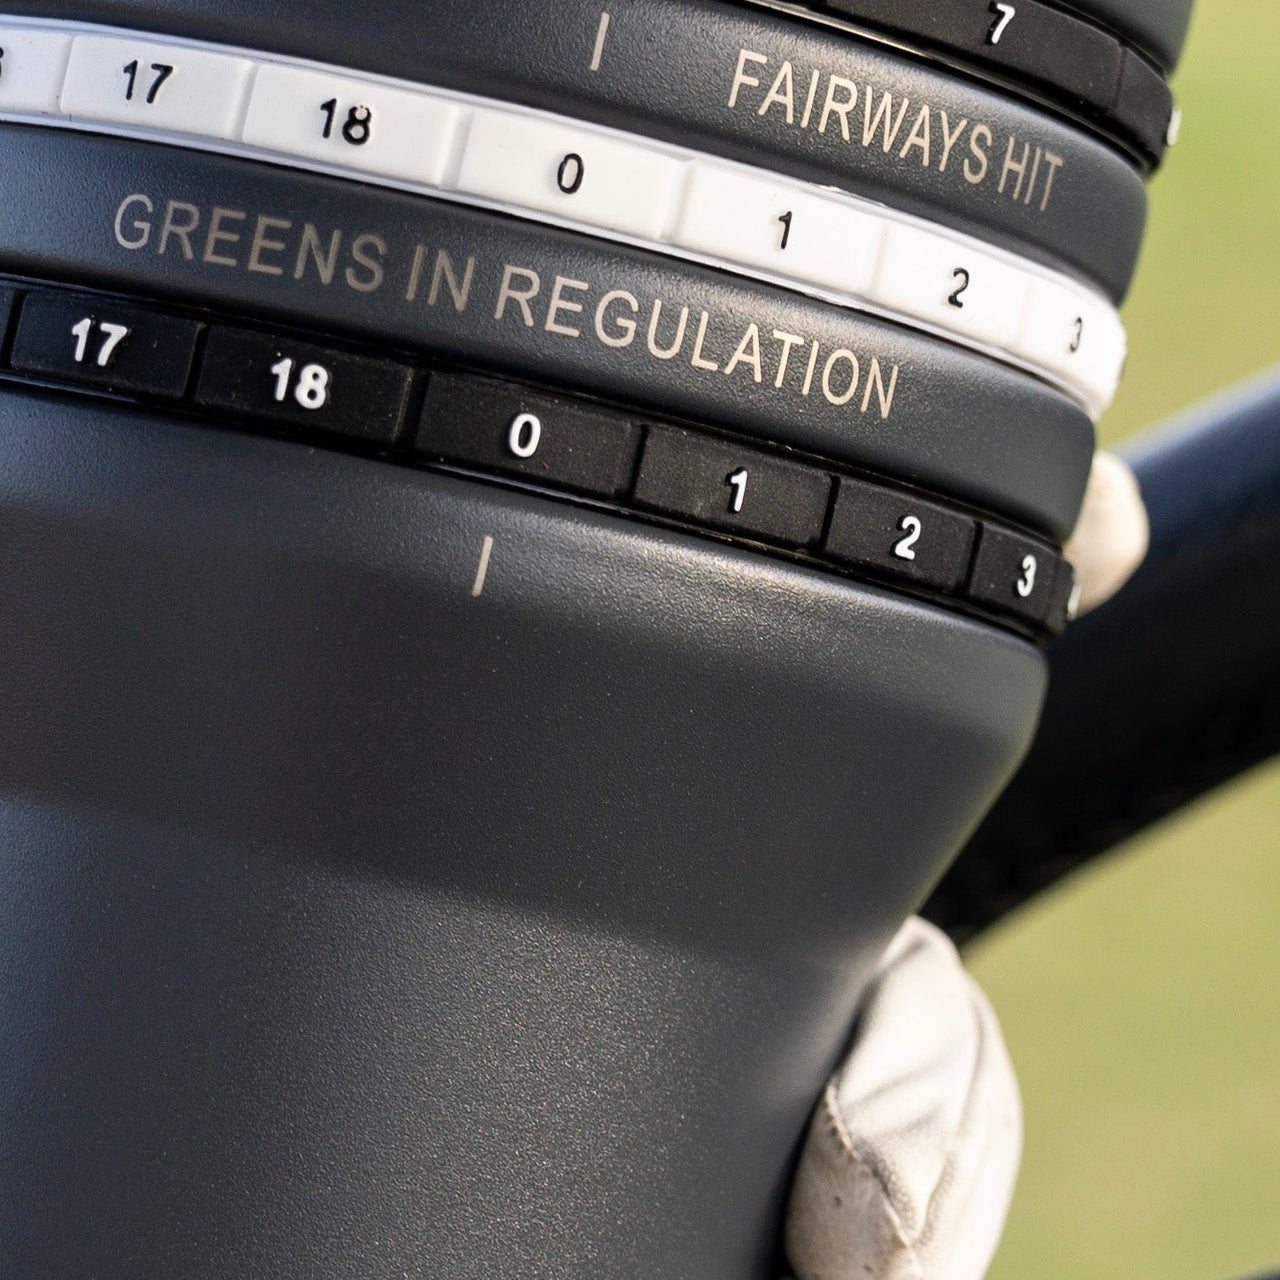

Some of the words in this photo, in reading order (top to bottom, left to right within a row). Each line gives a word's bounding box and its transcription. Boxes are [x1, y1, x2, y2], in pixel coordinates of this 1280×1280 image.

[727, 48, 991, 184] FAIRWAYS
[1002, 136, 1063, 210] HIT
[991, 3, 1015, 43] 7
[121, 60, 173, 104] 17
[320, 98, 372, 145] 18
[557, 153, 584, 194] 0
[778, 211, 792, 249] 1
[947, 267, 970, 308] 2
[114, 194, 384, 292] GREENS
[406, 244, 475, 312] IN
[495, 263, 898, 418] REGULATION
[71, 318, 127, 365] 17
[271, 358, 327, 409] 18
[508, 414, 541, 457] 0
[728, 468, 747, 511] 1
[894, 516, 921, 560] 2
[1017, 554, 1036, 597] 3
